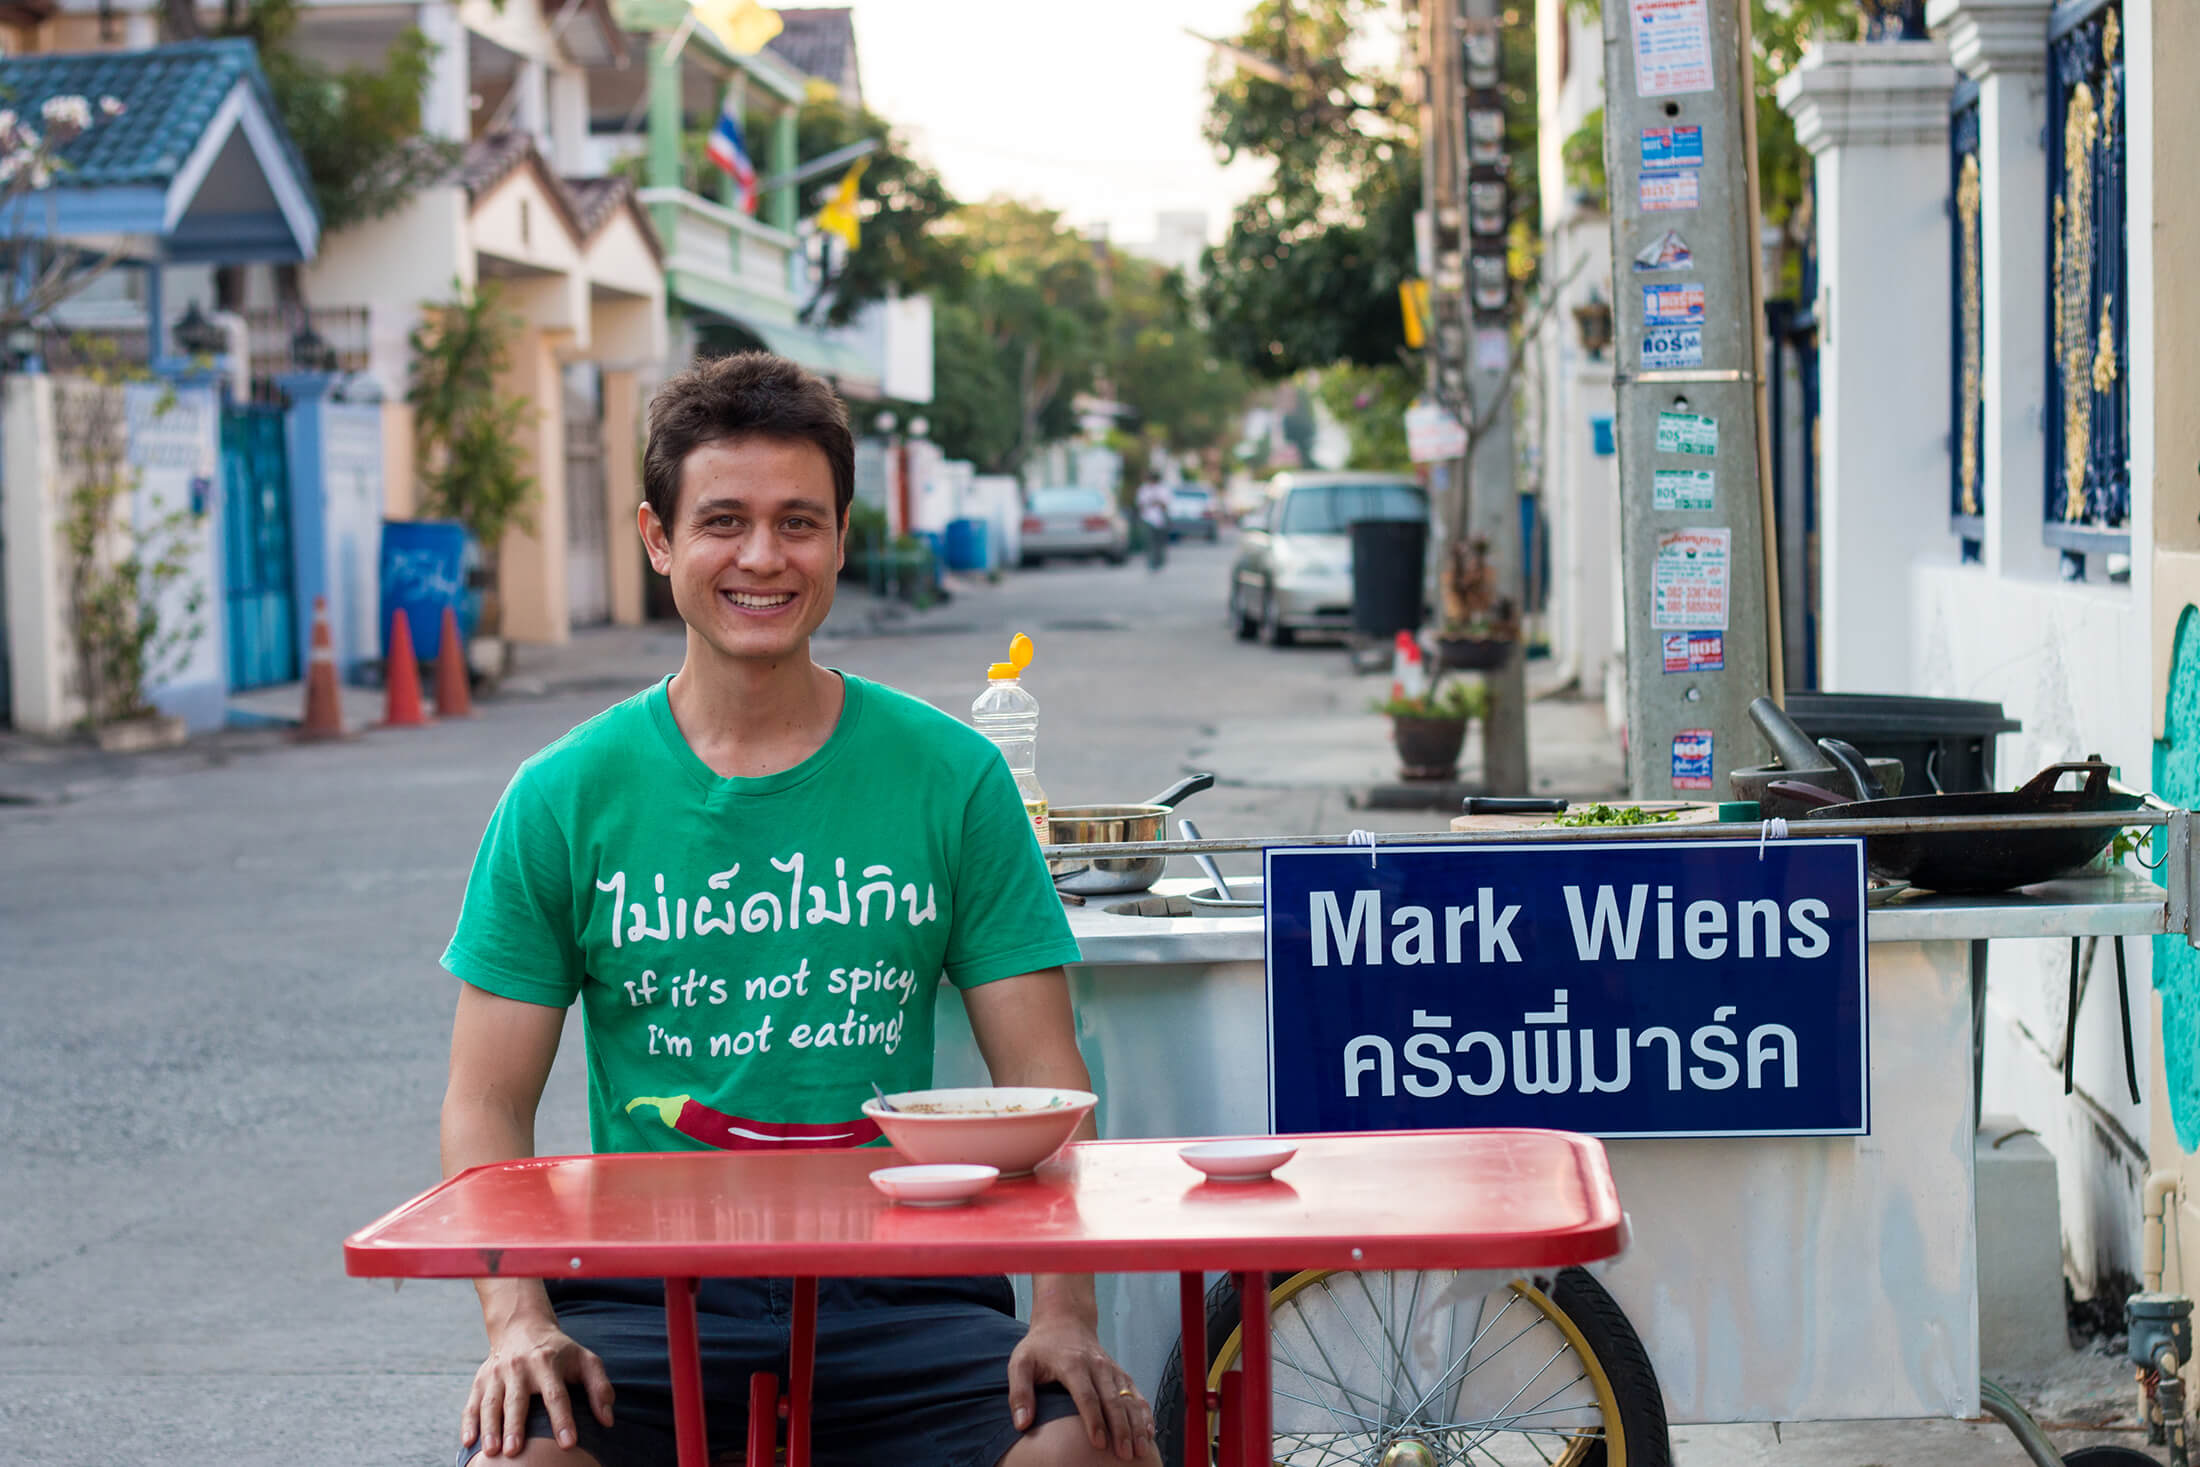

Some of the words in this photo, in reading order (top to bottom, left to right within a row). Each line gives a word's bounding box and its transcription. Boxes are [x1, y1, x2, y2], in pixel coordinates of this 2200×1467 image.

[596, 852, 937, 948] ไม่เผ็ดไม่กิน
[1309, 887, 1523, 967] Mark
[1562, 883, 1831, 961] Wiens
[623, 969, 659, 1006] If
[671, 967, 729, 1008] it's
[745, 957, 812, 1001] not
[827, 960, 918, 1006] spicy,
[647, 1023, 692, 1057] I'm
[709, 1014, 774, 1058] not
[788, 1008, 905, 1056] eating!
[1343, 987, 1799, 1099] ครัวพี่มาร์ค
